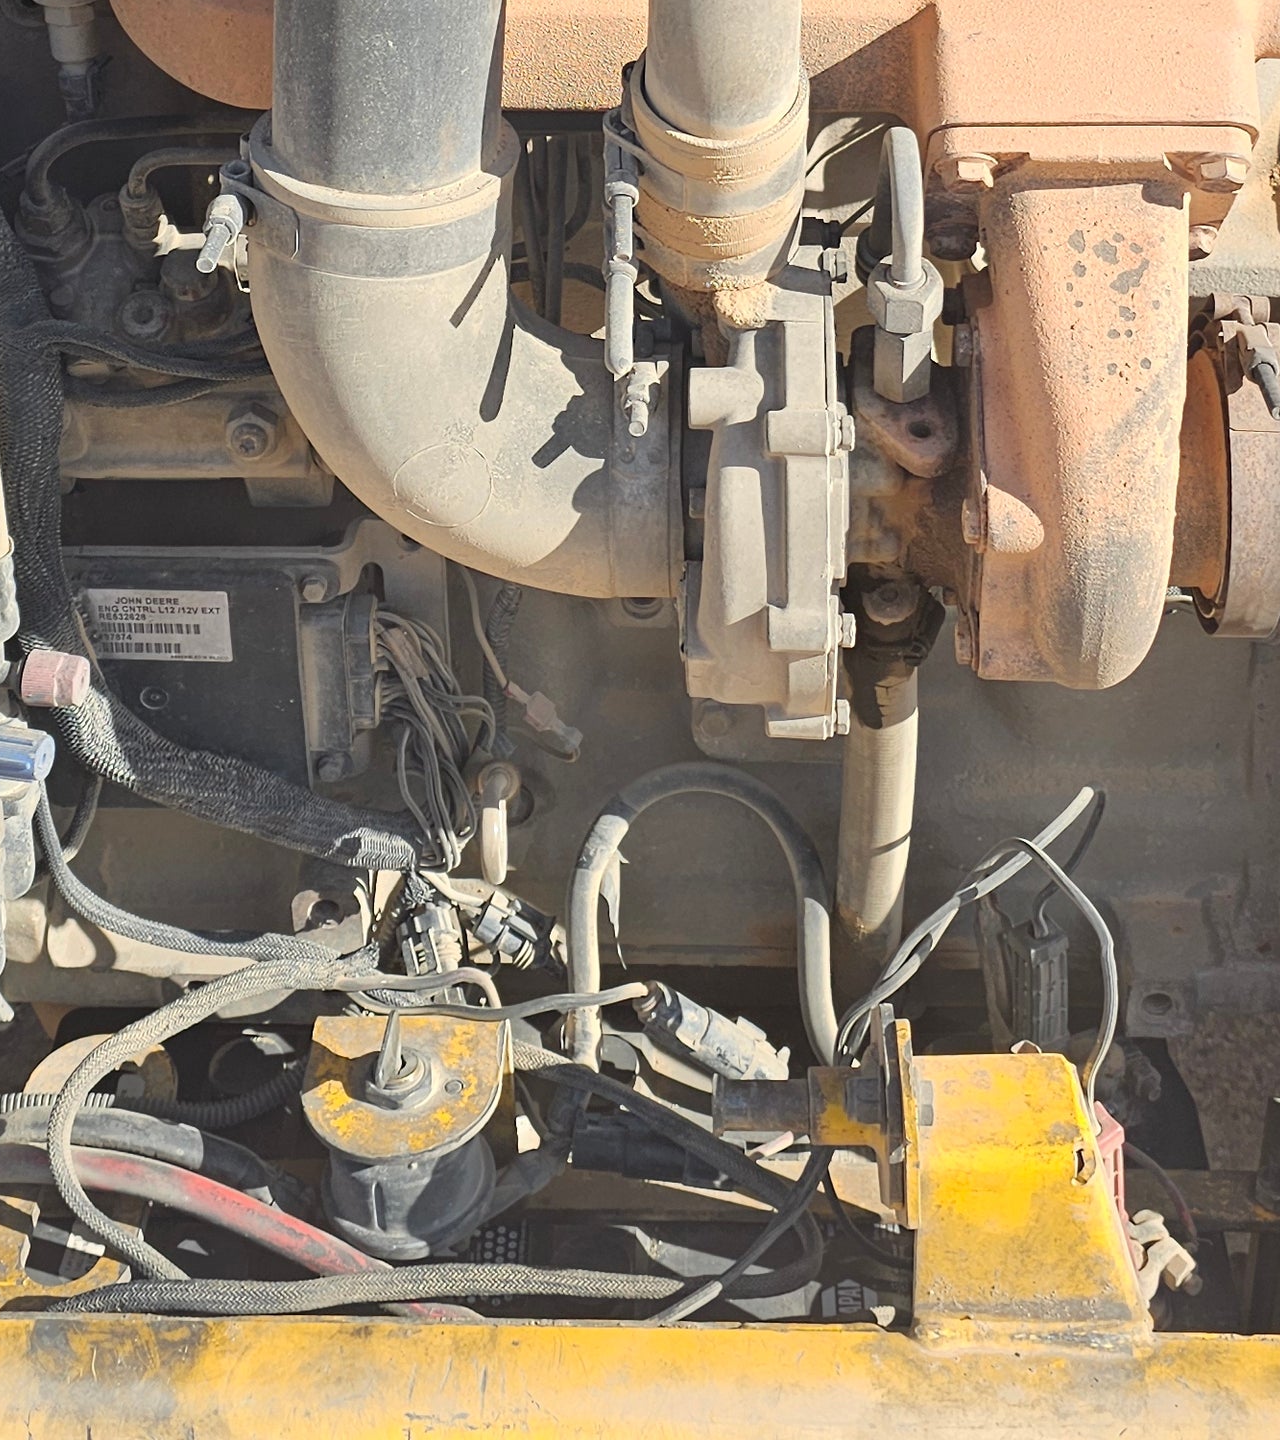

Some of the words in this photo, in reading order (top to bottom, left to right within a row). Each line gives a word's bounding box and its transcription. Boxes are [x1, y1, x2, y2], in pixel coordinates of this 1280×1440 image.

[115, 597, 142, 605] JOHN
[145, 598, 179, 606] DEERE
[98, 605, 119, 613] ENG
[122, 606, 156, 614] CNTRL
[158, 606, 176, 614] L12
[201, 607, 220, 615] EXT
